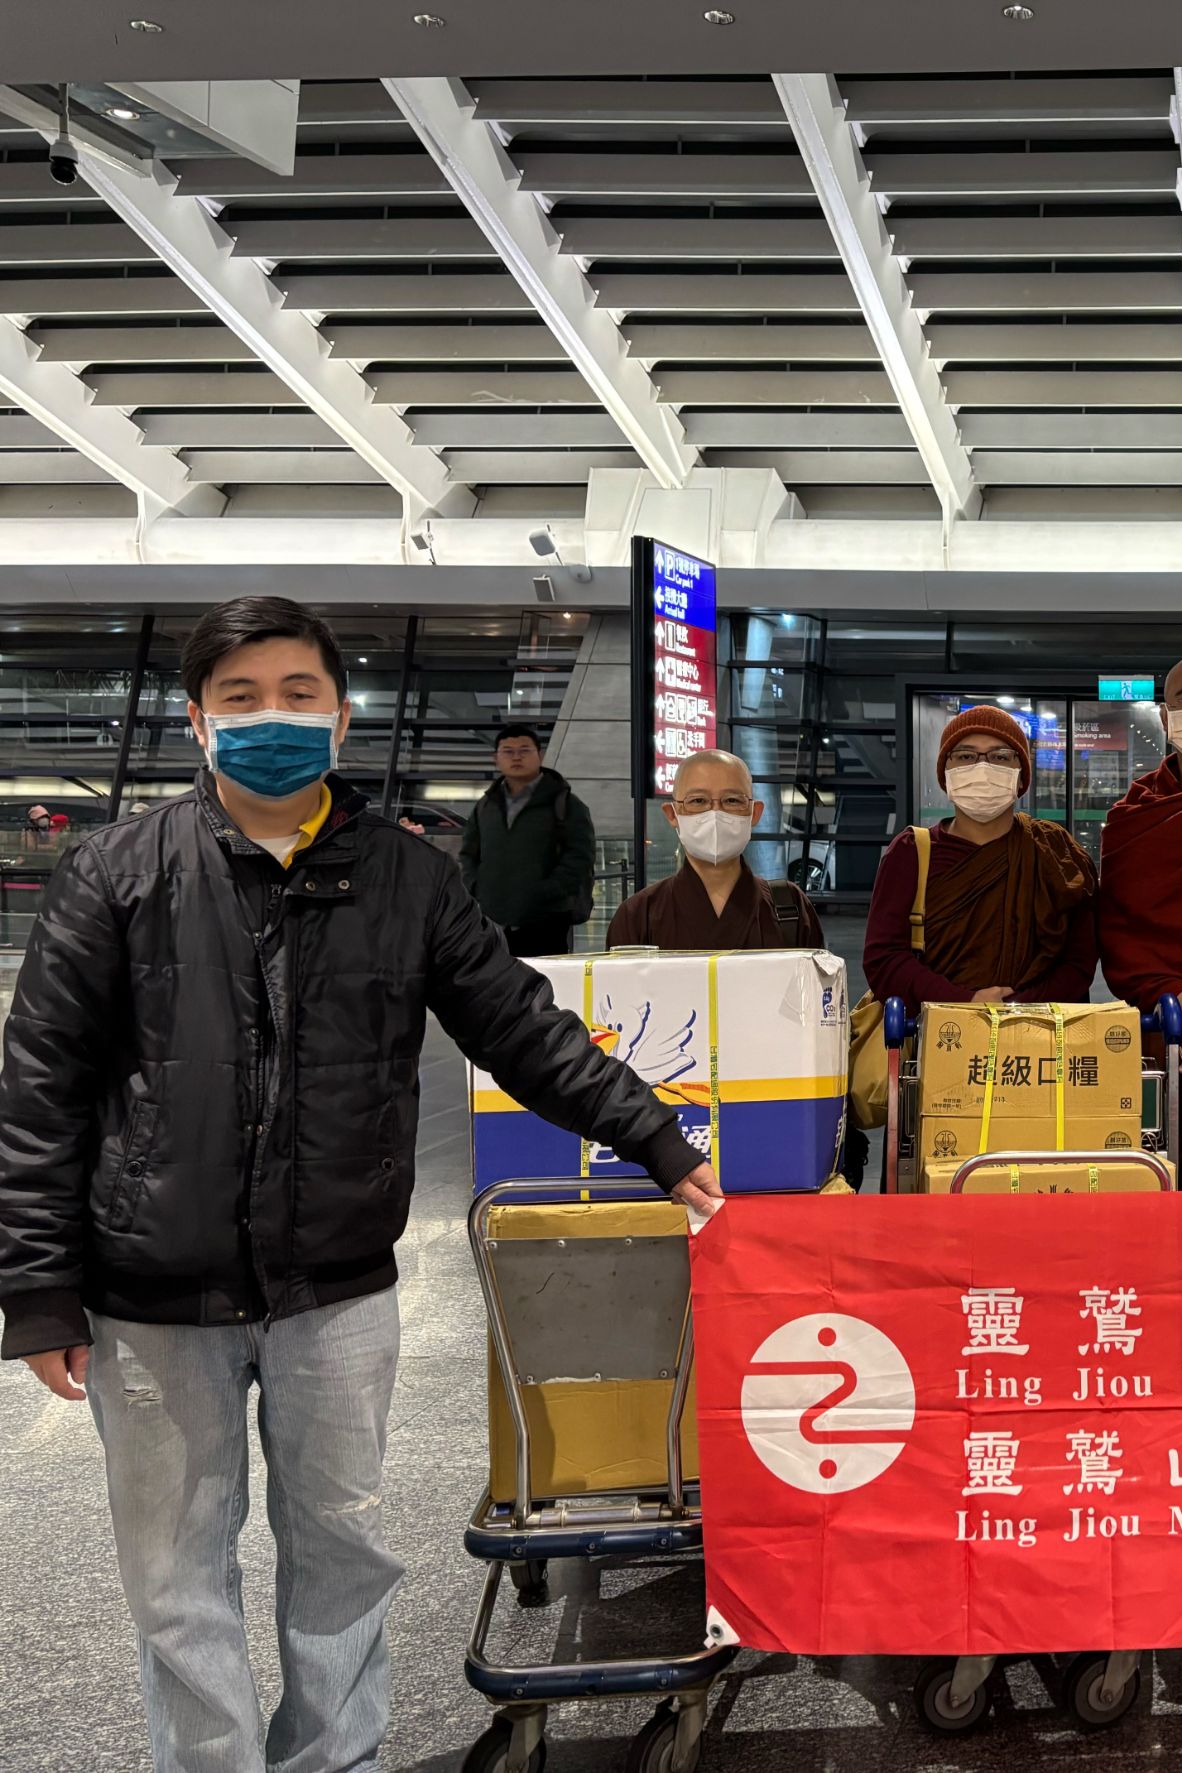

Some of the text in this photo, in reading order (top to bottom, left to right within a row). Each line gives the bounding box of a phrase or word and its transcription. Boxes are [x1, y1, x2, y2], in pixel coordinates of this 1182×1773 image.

[967, 1054, 1099, 1087] 超級口糧
[955, 1369, 1042, 1406] Ling
[1072, 1367, 1154, 1402] Jiou
[955, 1510, 1037, 1548] Ling
[1063, 1507, 1141, 1542] Jiou
